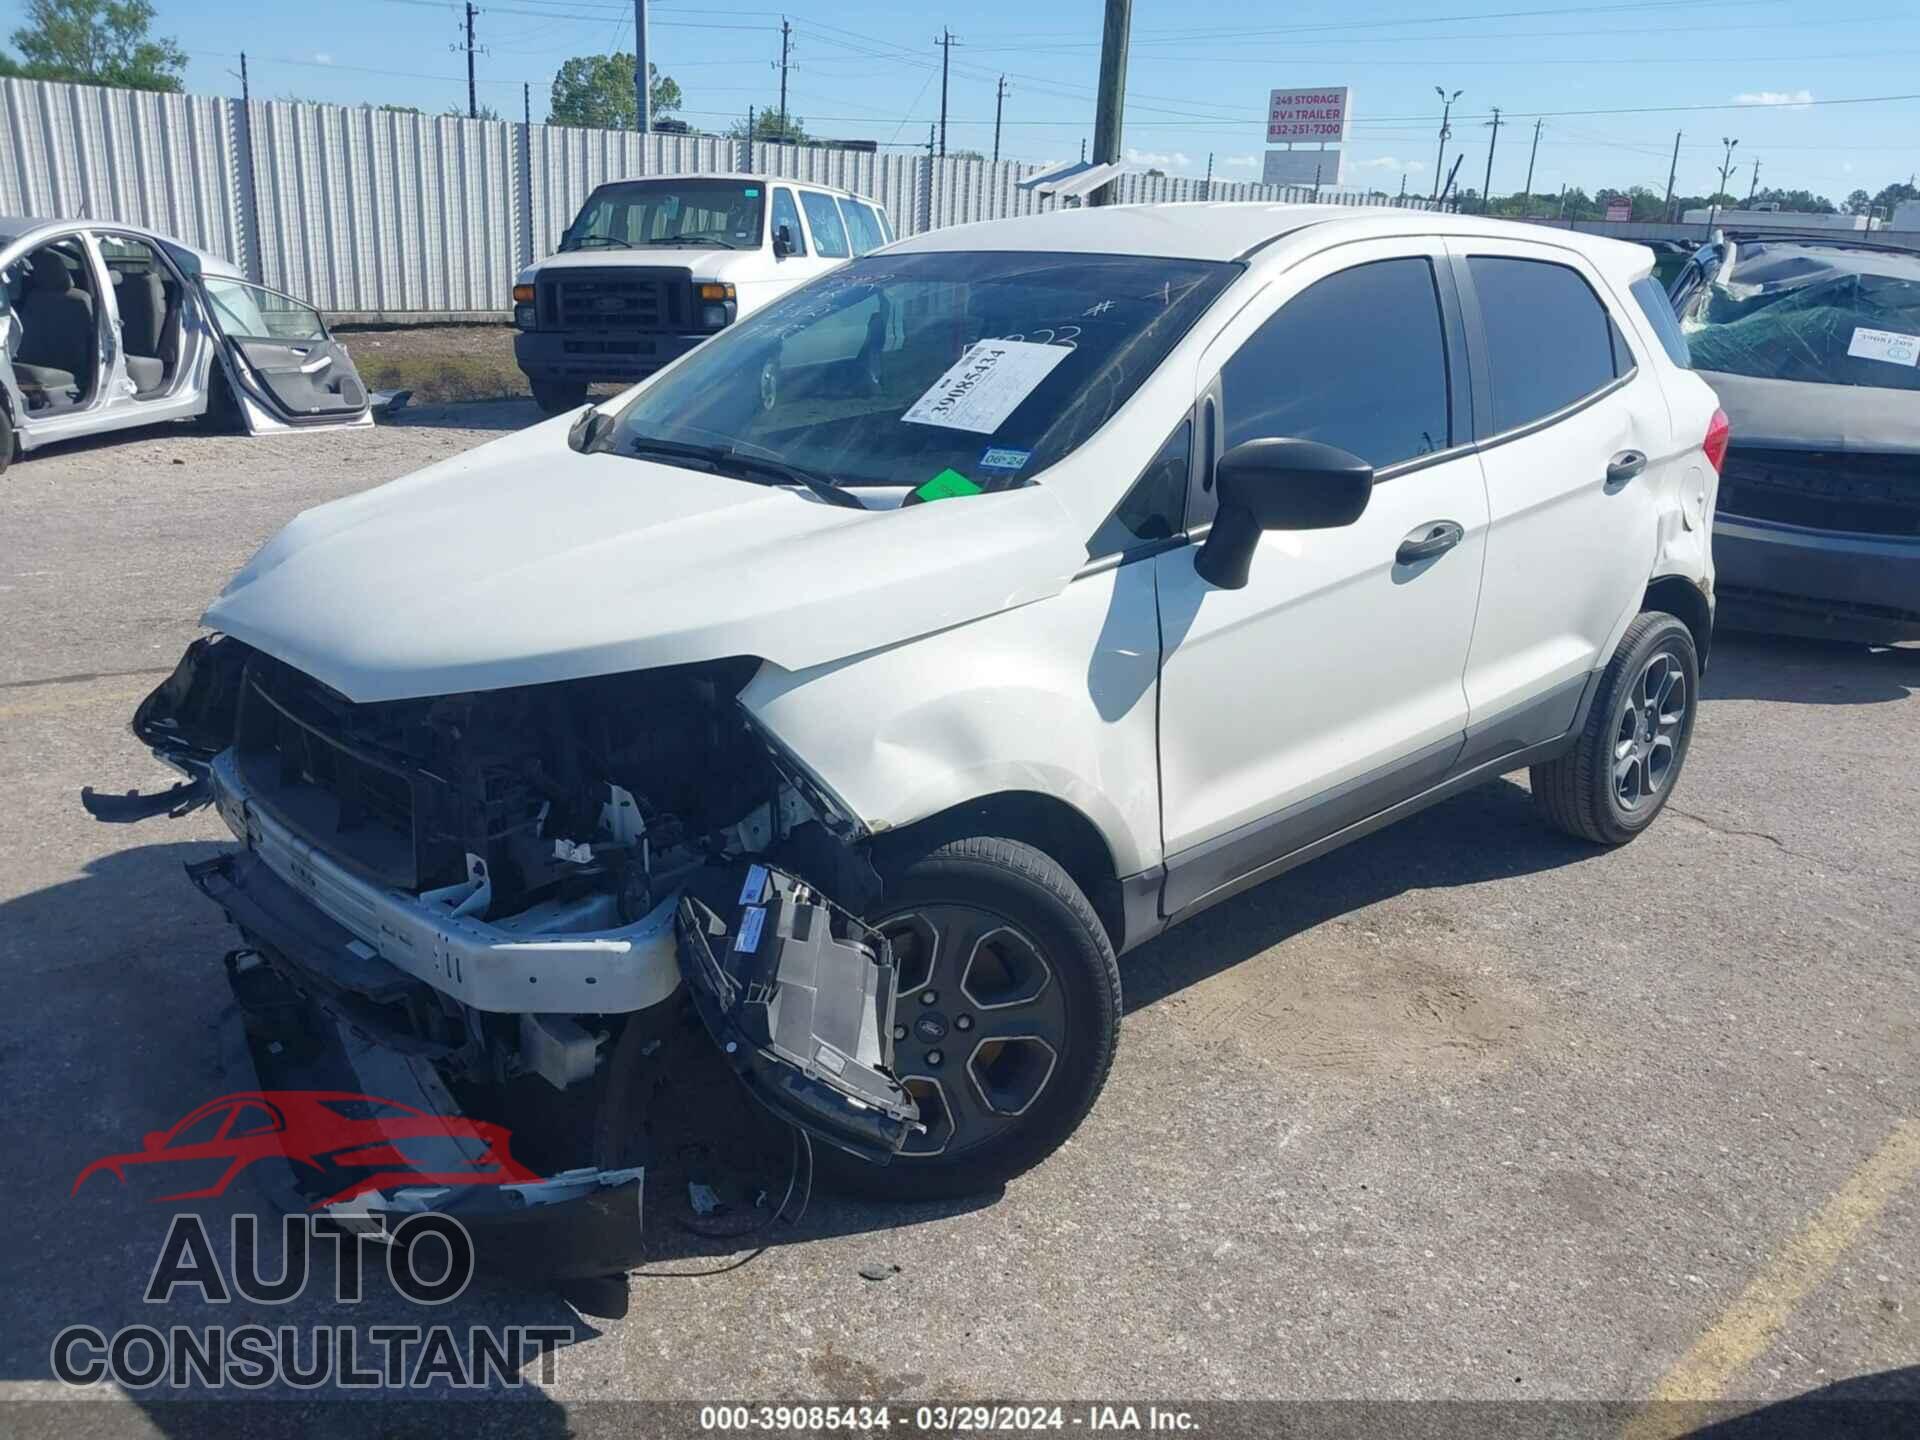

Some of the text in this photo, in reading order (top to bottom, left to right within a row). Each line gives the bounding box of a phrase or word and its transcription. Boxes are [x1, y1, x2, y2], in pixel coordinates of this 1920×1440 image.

[1295, 94, 1341, 105] STORAGE
[1295, 109, 1341, 120] TRAILER
[1270, 124, 1340, 135] 832-251-7300
[931, 349, 1006, 416] 39085434
